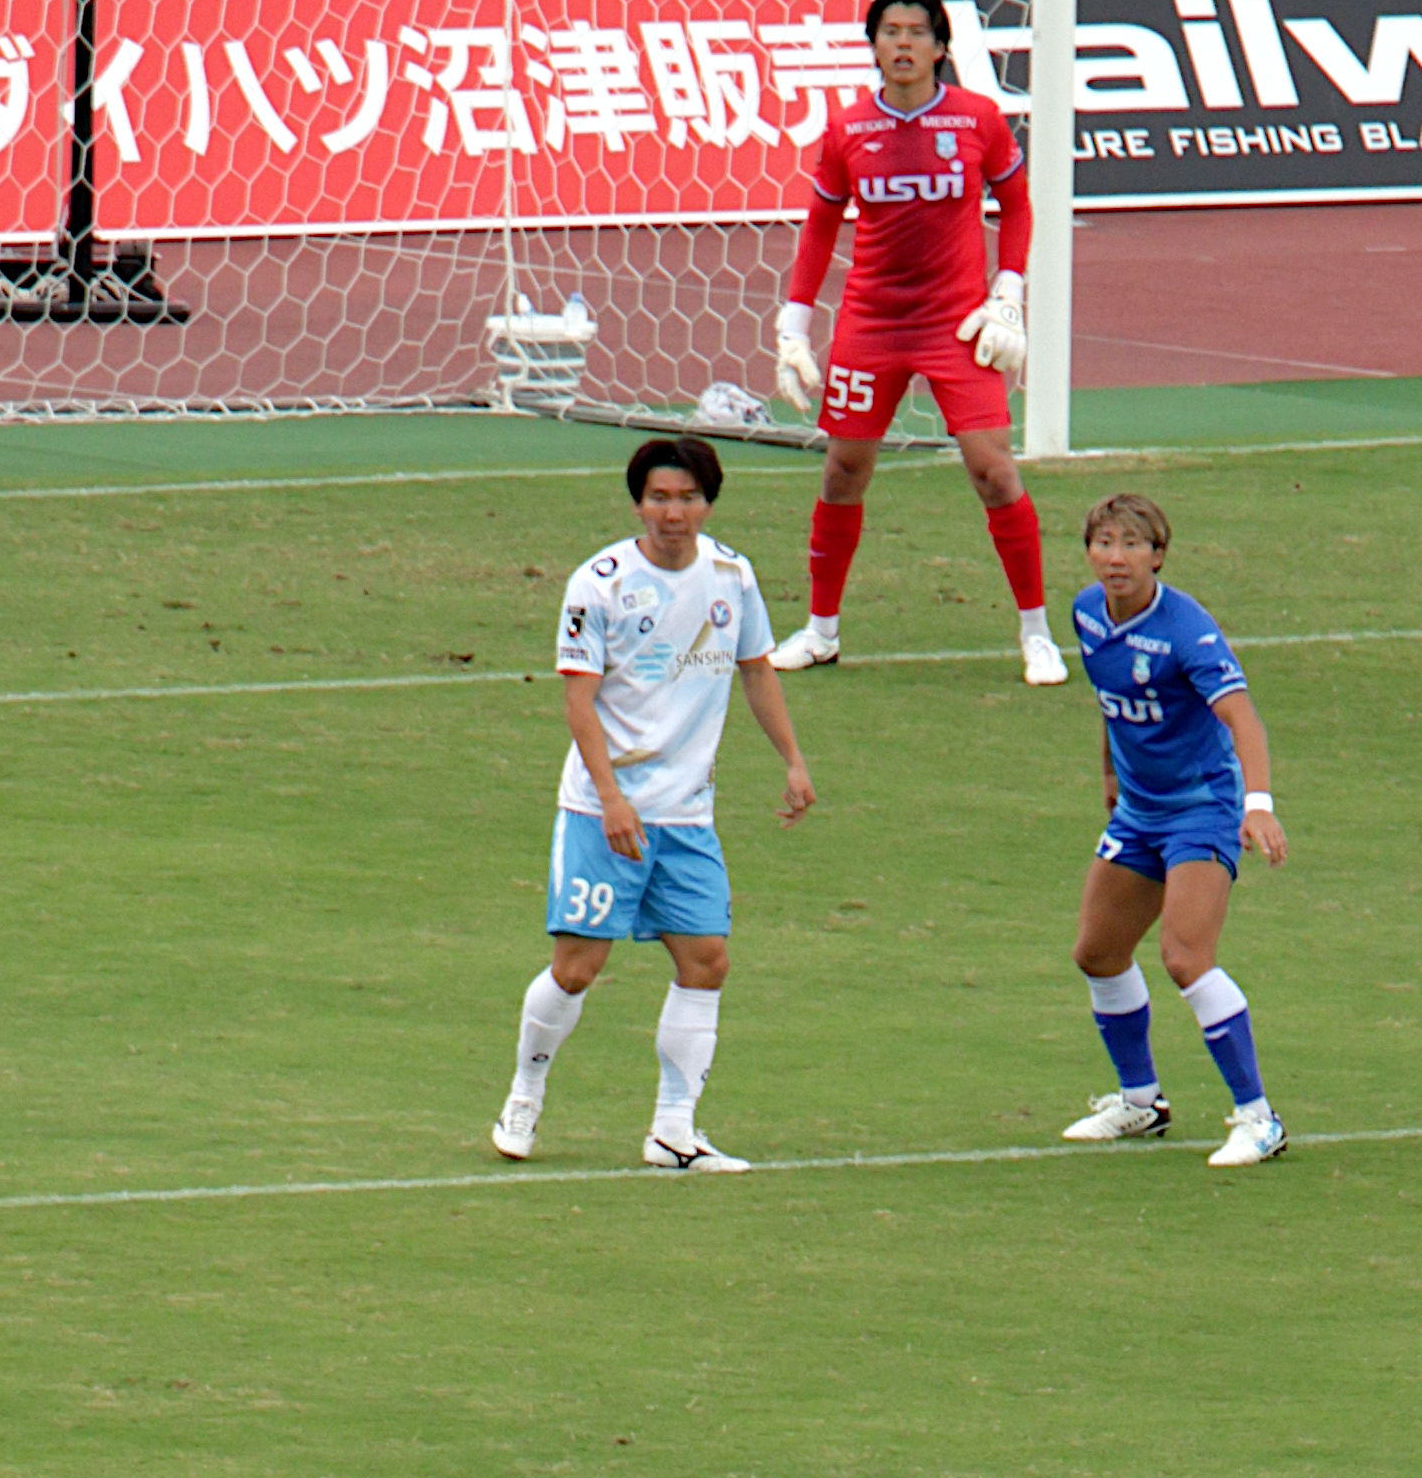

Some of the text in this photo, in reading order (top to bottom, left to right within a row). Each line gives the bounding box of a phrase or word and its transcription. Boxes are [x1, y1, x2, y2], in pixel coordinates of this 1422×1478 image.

[919, 115, 977, 130] MEIDEN
[1169, 123, 1344, 157] FISHING
[826, 364, 876, 413] 55
[564, 877, 615, 927] 39
